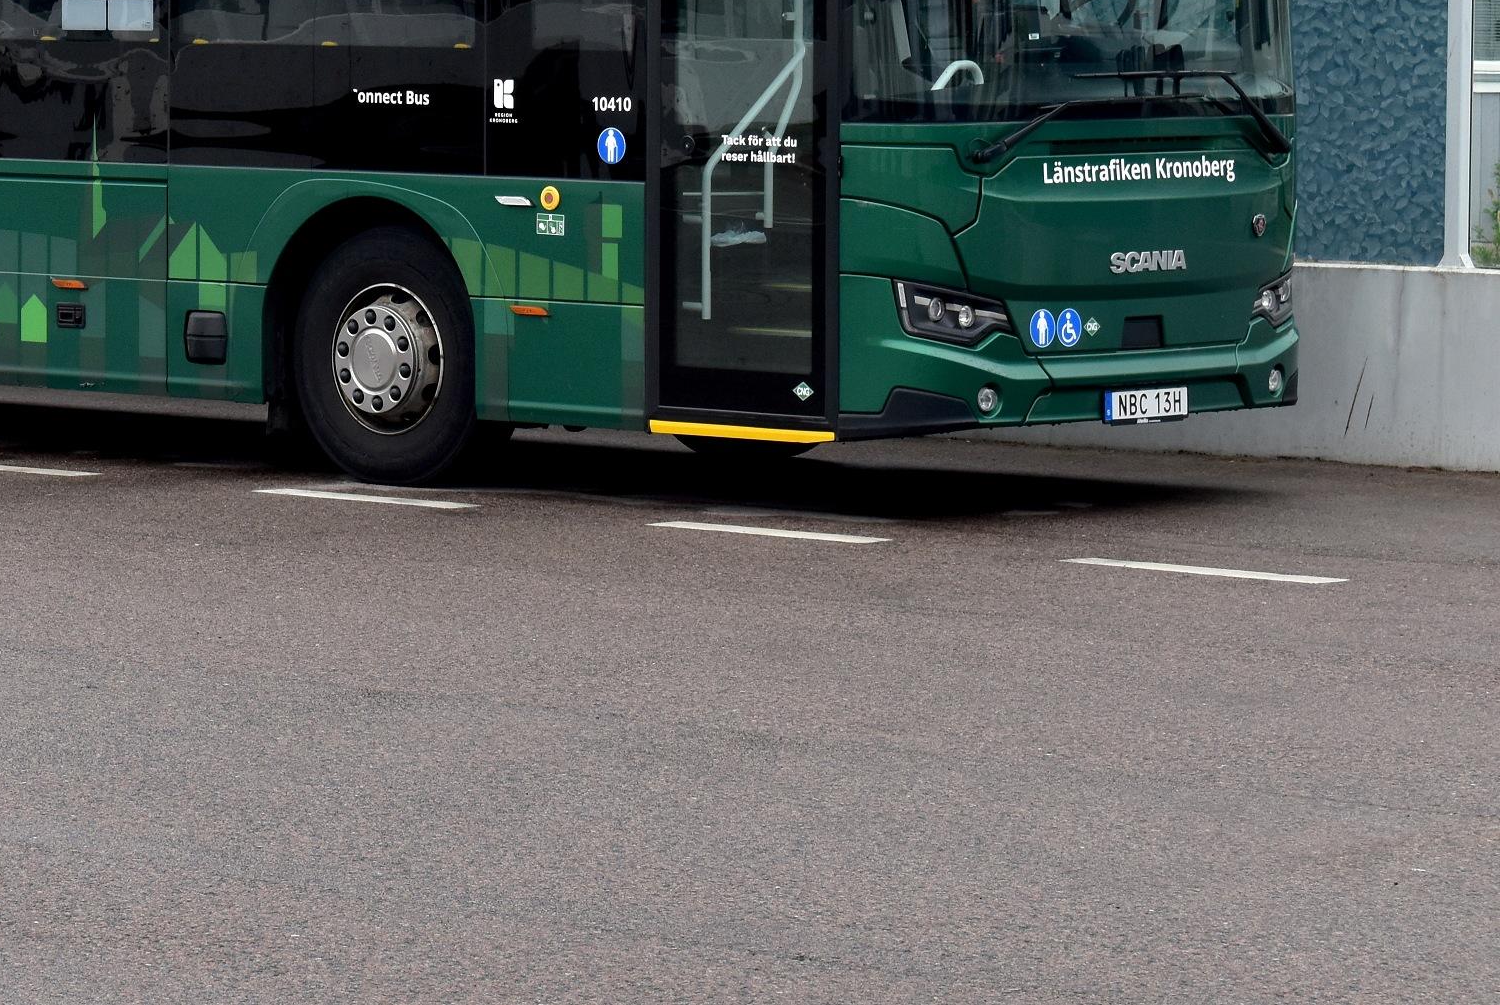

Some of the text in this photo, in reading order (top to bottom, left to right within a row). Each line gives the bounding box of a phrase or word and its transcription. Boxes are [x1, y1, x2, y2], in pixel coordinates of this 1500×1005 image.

[352, 88, 430, 105] onnect Bus
[592, 96, 632, 112] 10410
[721, 134, 798, 148] Tack för att du
[721, 150, 796, 164] reser hållbart!
[1043, 155, 1236, 184] Länstrafiken Kronoberg
[1110, 249, 1187, 274] SCANIA
[796, 387, 811, 396] CNG
[1118, 390, 1182, 417] NBC 13H
